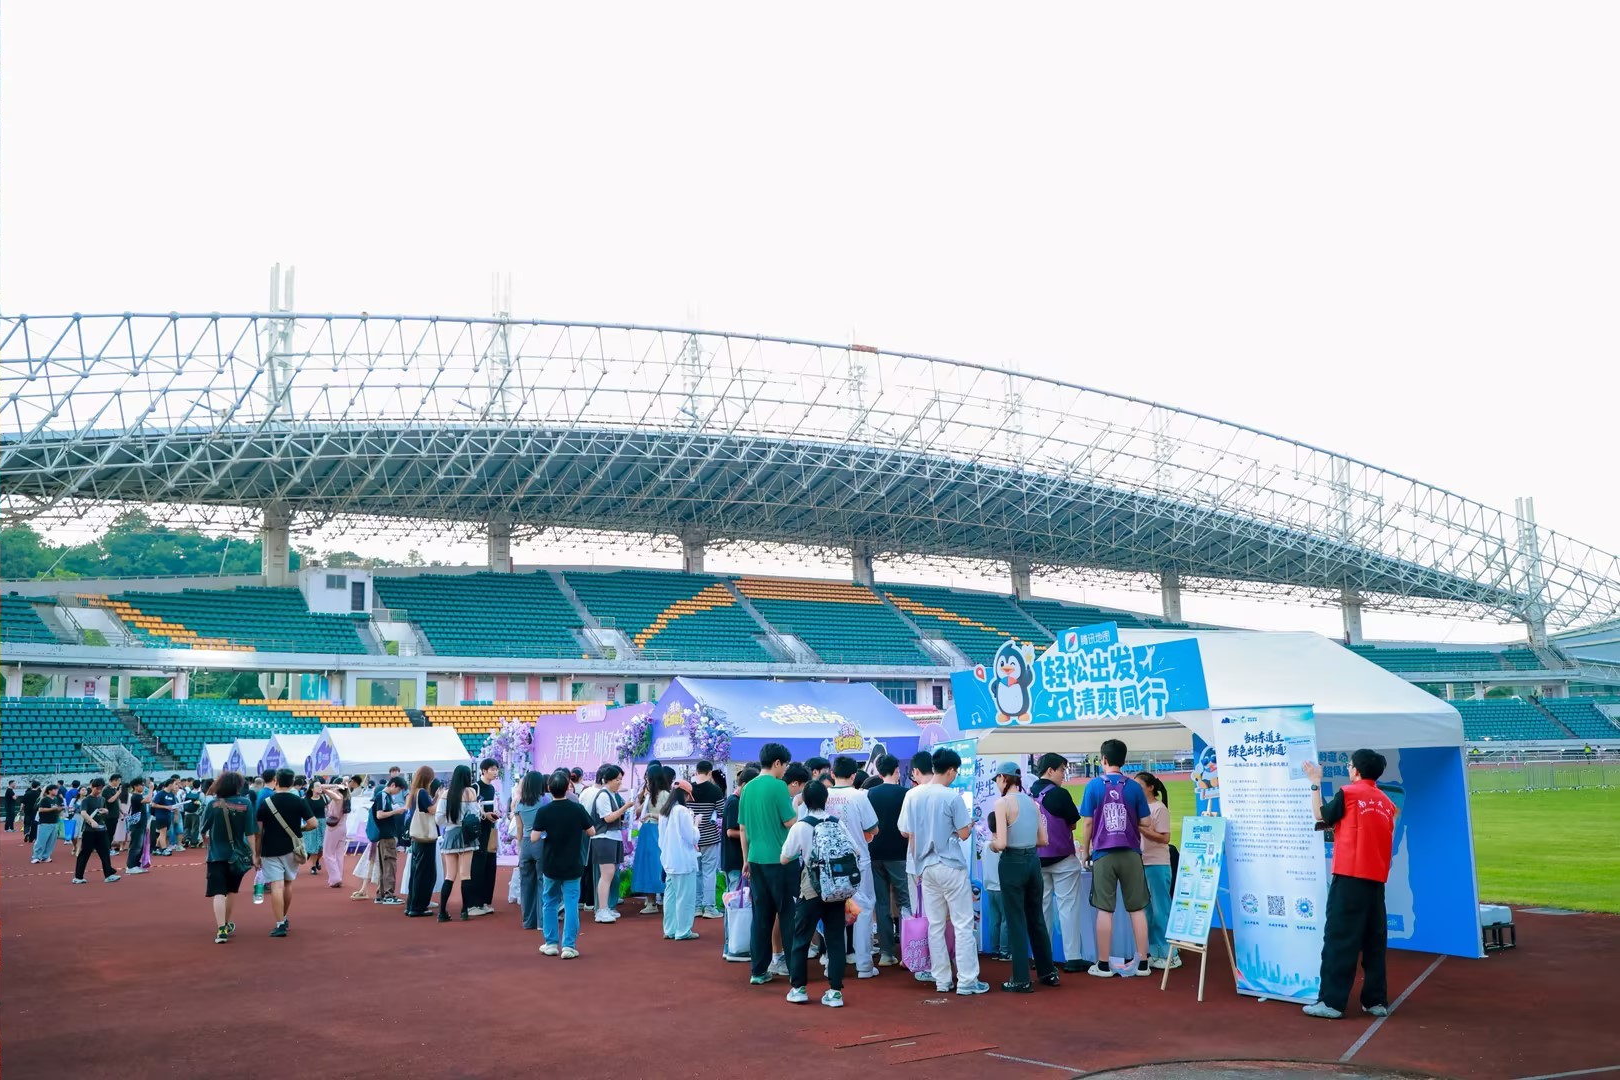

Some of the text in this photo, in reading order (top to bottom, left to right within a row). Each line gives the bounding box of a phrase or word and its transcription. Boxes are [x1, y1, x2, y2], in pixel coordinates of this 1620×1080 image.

[1080, 631, 1111, 644] 腾讯地图
[1044, 647, 1135, 689] 轻松出发
[1077, 680, 1167, 718] 清爽同行
[1244, 730, 1285, 744] 当好东道主
[1228, 743, 1287, 762] 绿色出行、畅通
